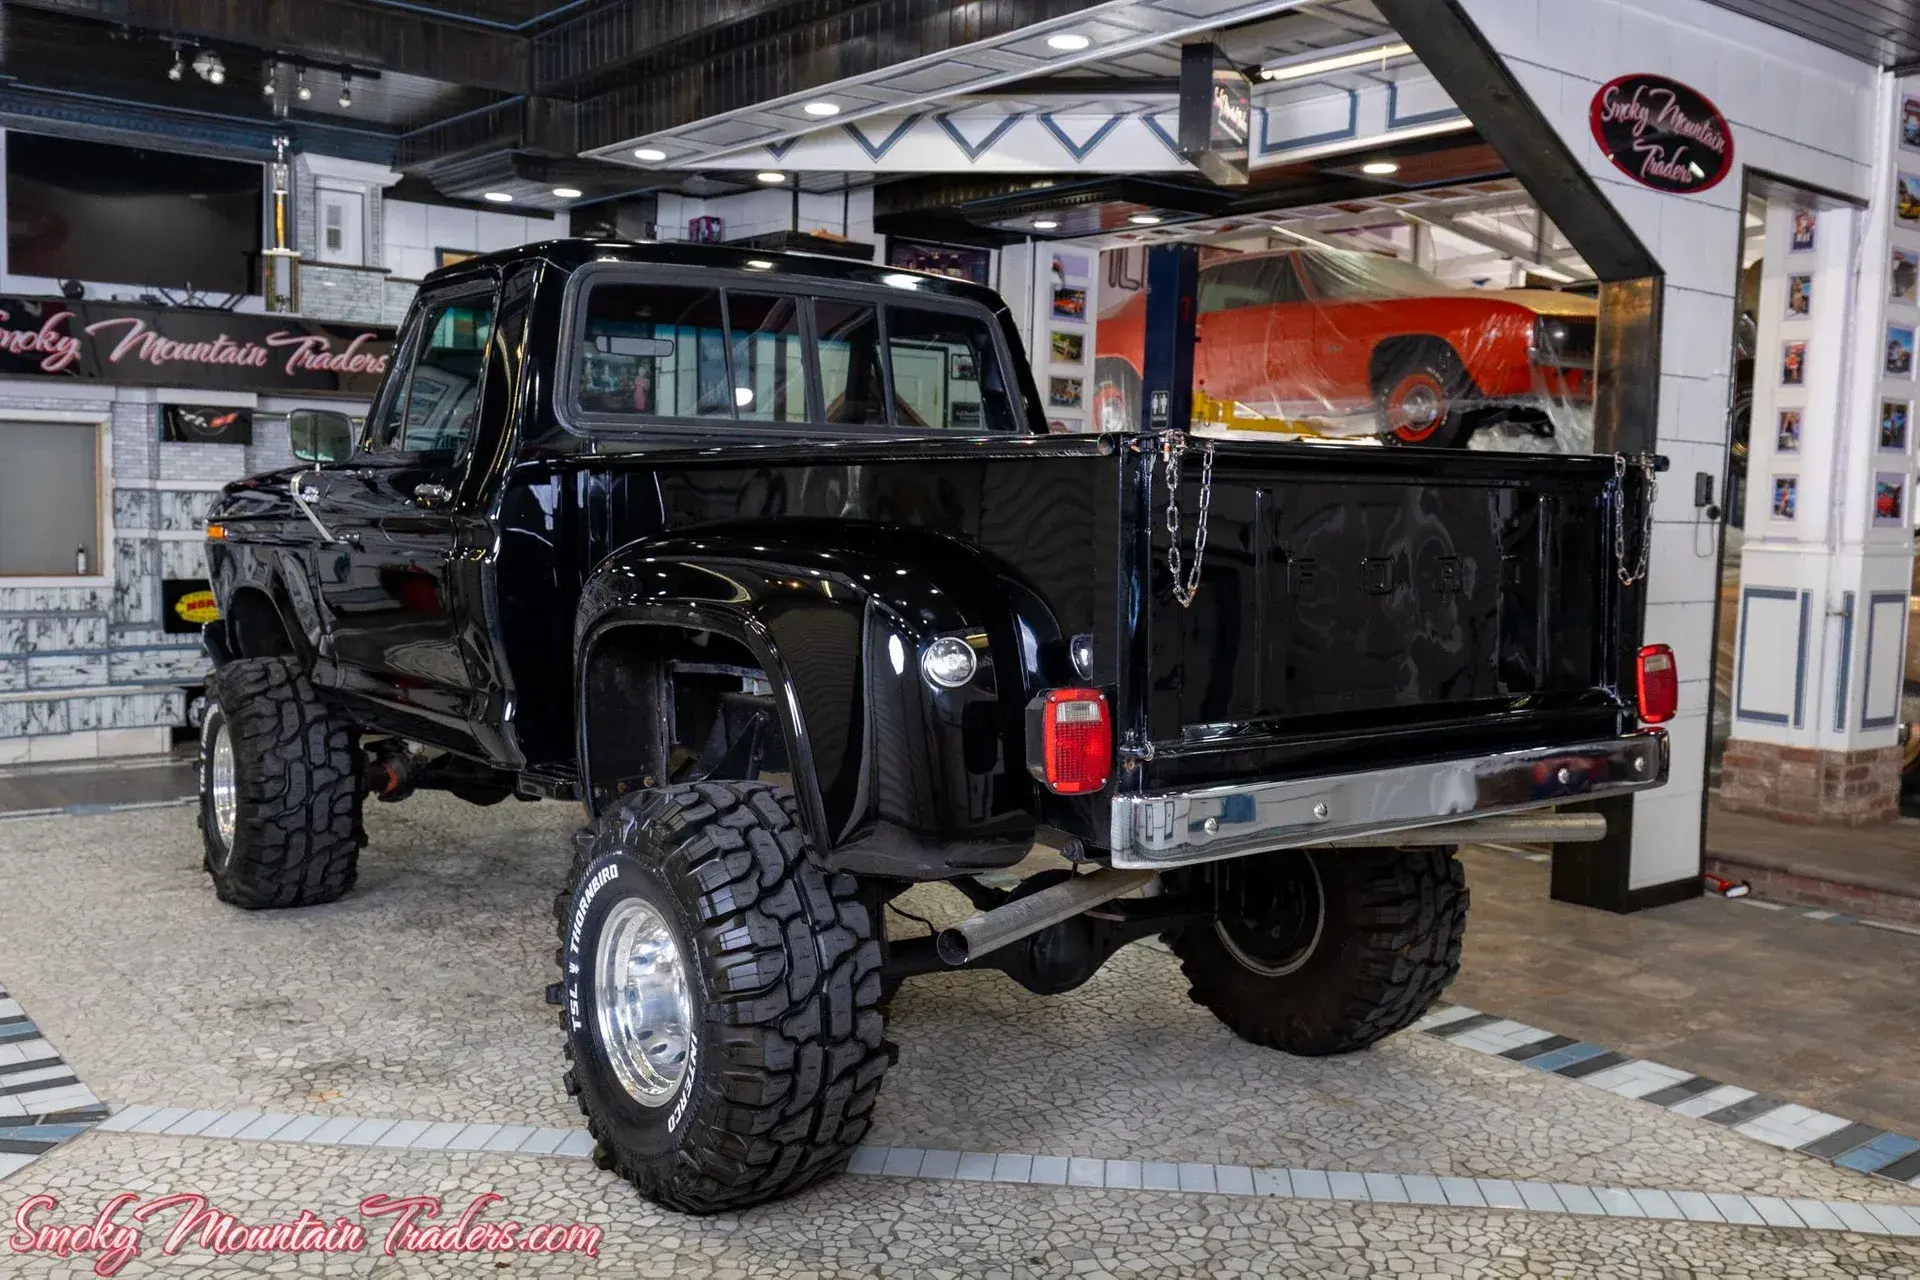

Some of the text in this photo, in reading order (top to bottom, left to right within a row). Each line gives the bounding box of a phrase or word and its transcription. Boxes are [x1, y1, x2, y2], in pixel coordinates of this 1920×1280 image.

[1601, 84, 1726, 155] Smoky Mountain
[1632, 138, 1694, 183] Traders
[0, 309, 390, 376] moky Mountain Traders
[568, 863, 620, 1033] TSL THORNBIRD
[667, 1031, 699, 1134] INTERCO
